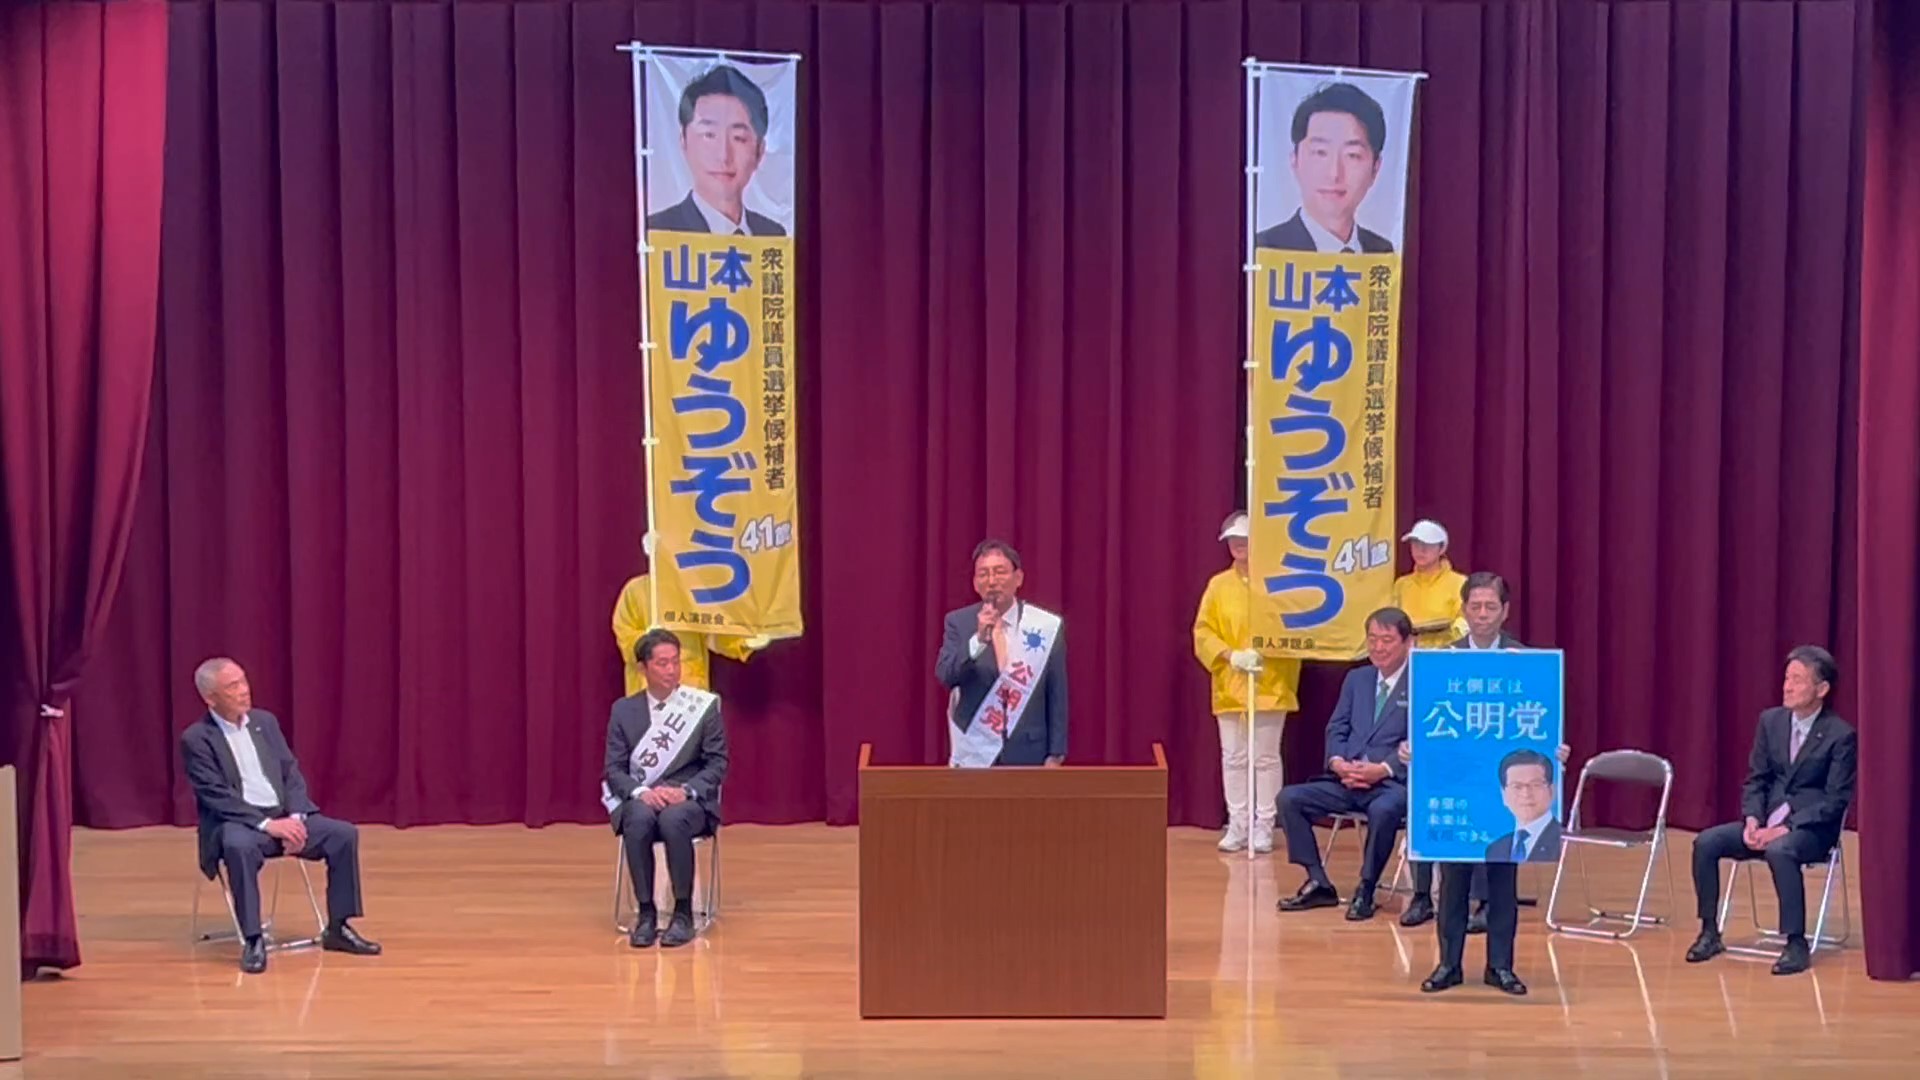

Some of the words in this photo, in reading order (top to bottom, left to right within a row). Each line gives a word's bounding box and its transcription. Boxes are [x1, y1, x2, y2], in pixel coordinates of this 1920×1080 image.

[663, 244, 752, 293] 山本
[1268, 262, 1362, 313] 山本
[761, 247, 786, 491] 衆議院議員選挙候補者
[1362, 265, 1391, 509] 衆議院議員選挙候補者
[670, 298, 757, 603] ゆうぞう
[1264, 316, 1355, 630] ゆうぞう
[979, 661, 1034, 735] 公明党
[1423, 700, 1548, 740] 公明党
